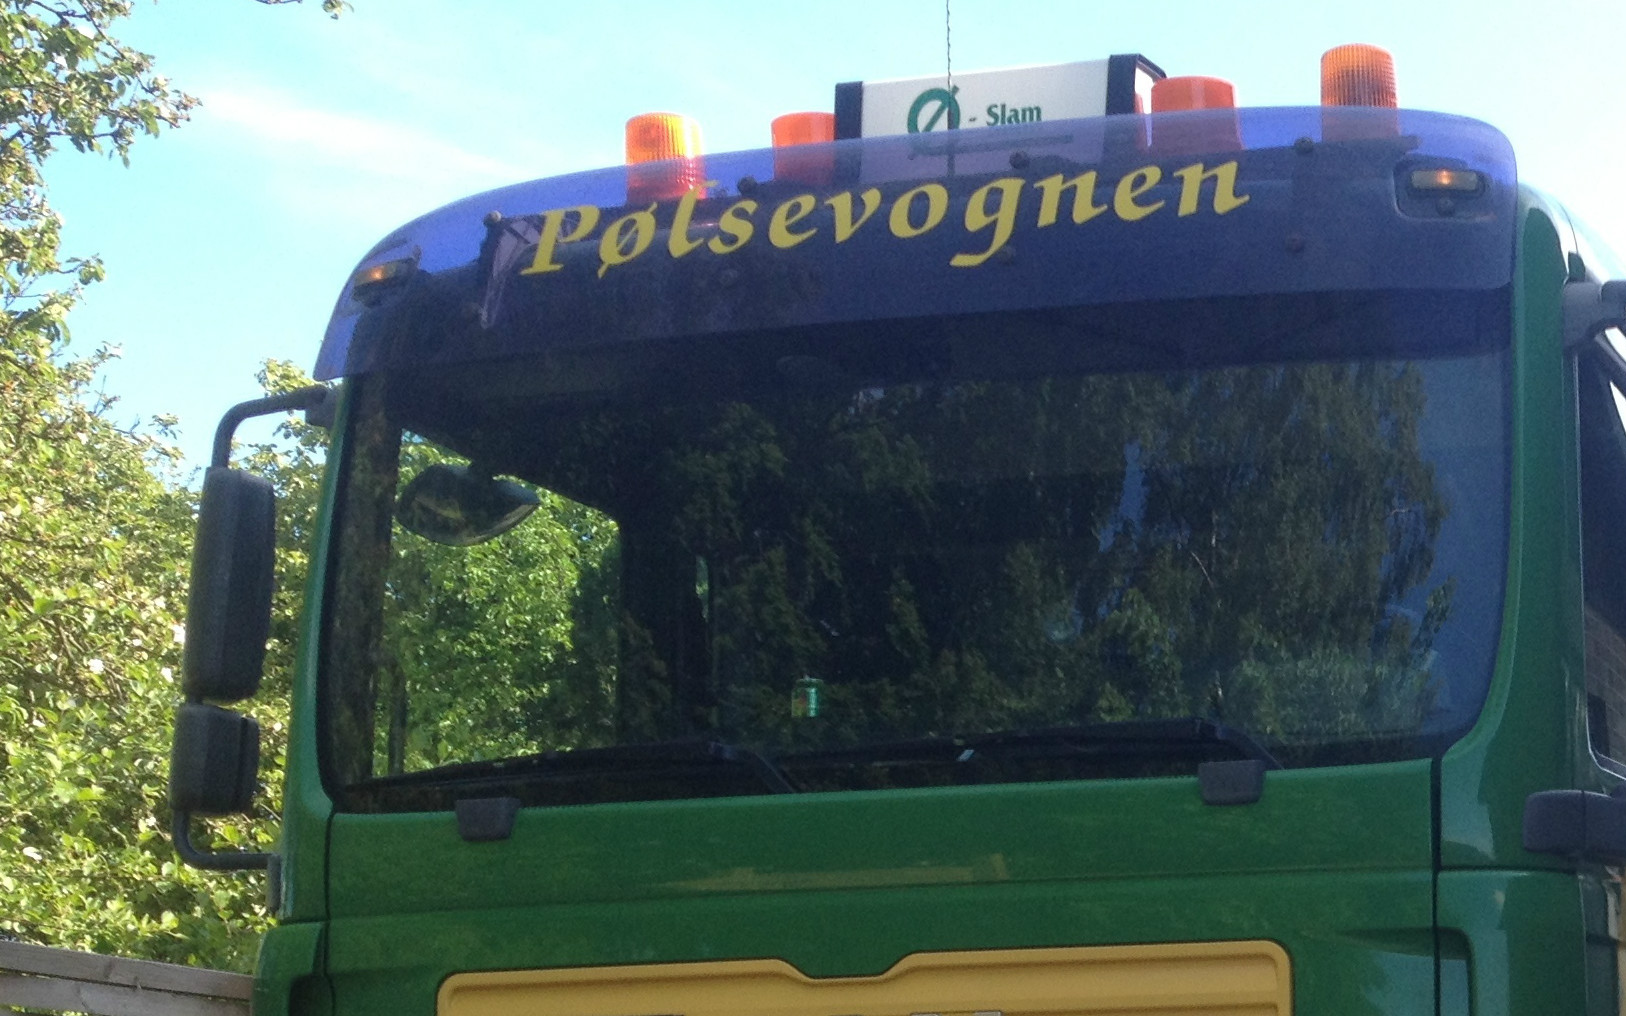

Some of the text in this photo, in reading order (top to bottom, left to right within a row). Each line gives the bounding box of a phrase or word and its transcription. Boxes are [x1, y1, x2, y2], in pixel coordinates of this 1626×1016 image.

[906, 84, 961, 142] Ø
[986, 103, 1042, 127] Slam
[519, 157, 1250, 277] Pølsevognen
